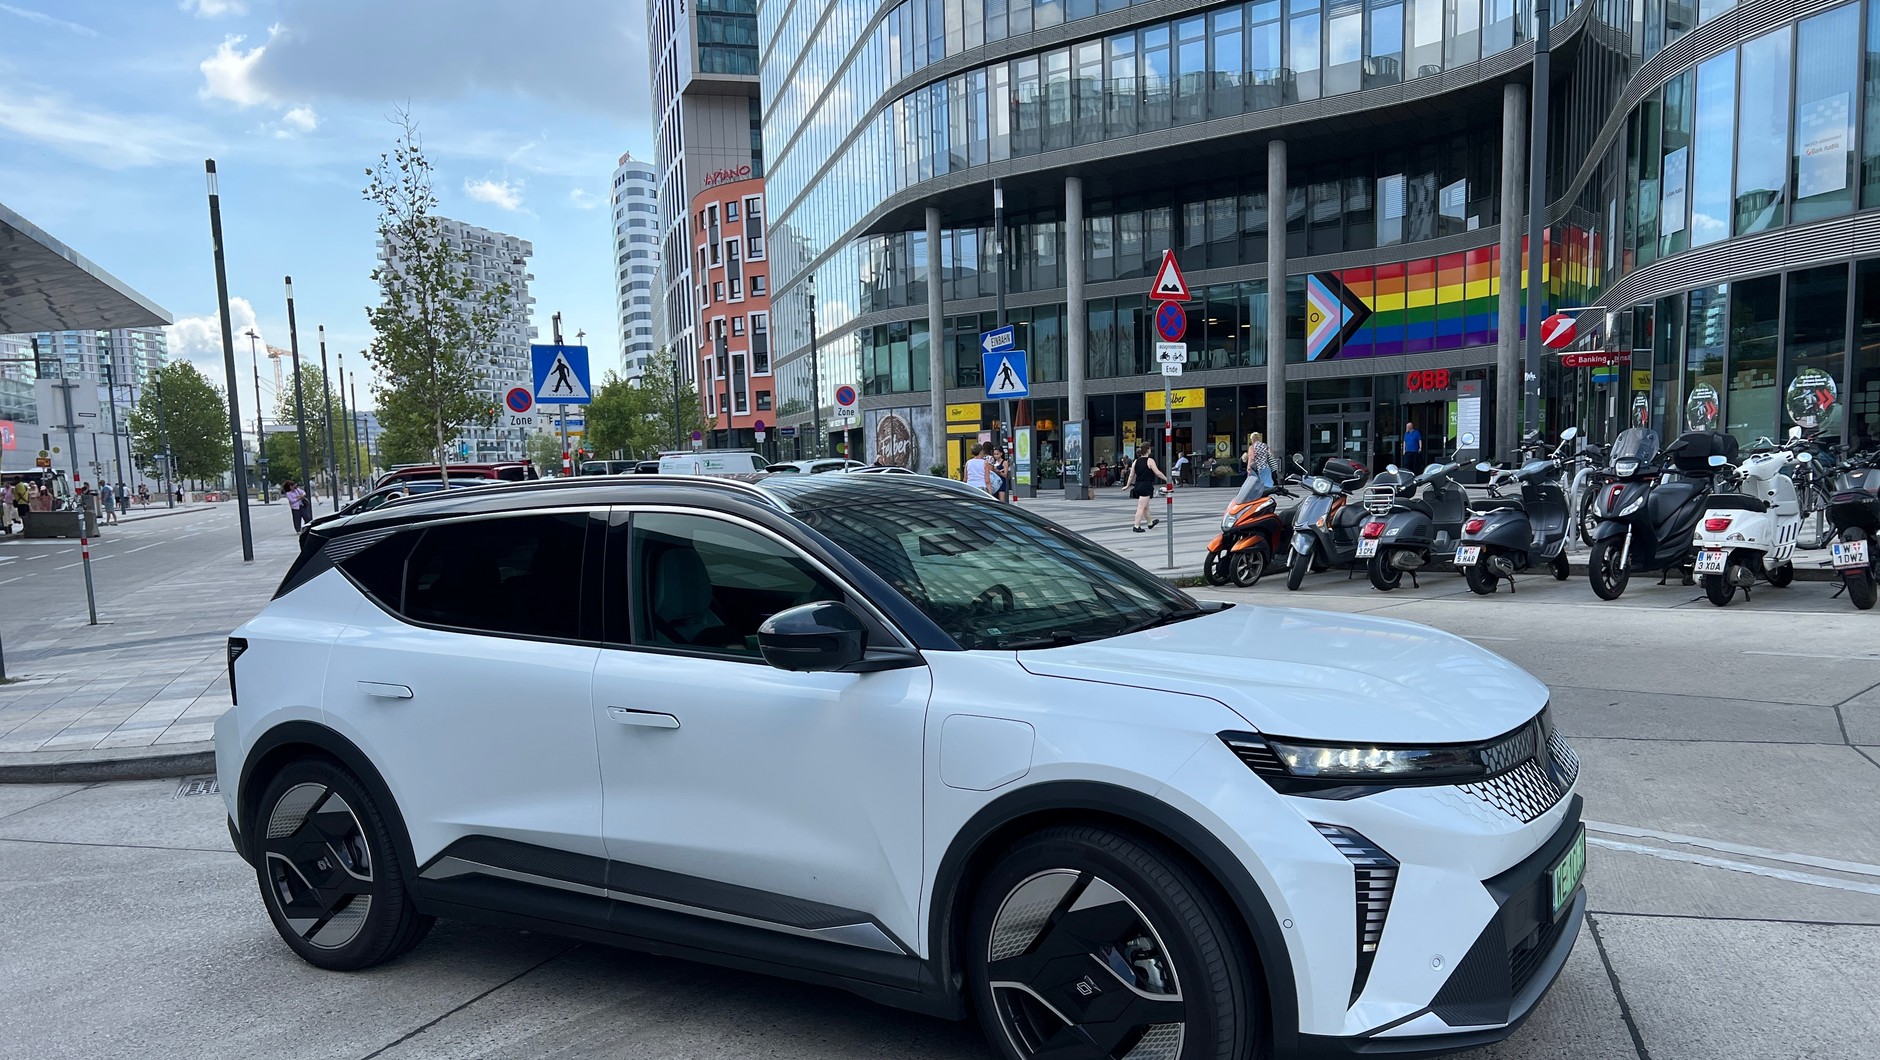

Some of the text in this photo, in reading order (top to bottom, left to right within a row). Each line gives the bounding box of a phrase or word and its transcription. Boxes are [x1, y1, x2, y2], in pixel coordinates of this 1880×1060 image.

[990, 333, 1011, 347] EINBAHN
[1578, 355, 1607, 364] Banking
[1165, 365, 1178, 373] Ende
[1407, 368, 1449, 391] ÖBB
[837, 408, 855, 416] Zone
[510, 415, 532, 425] Zone
[1843, 544, 1850, 553] W
[1706, 553, 1713, 561] W
